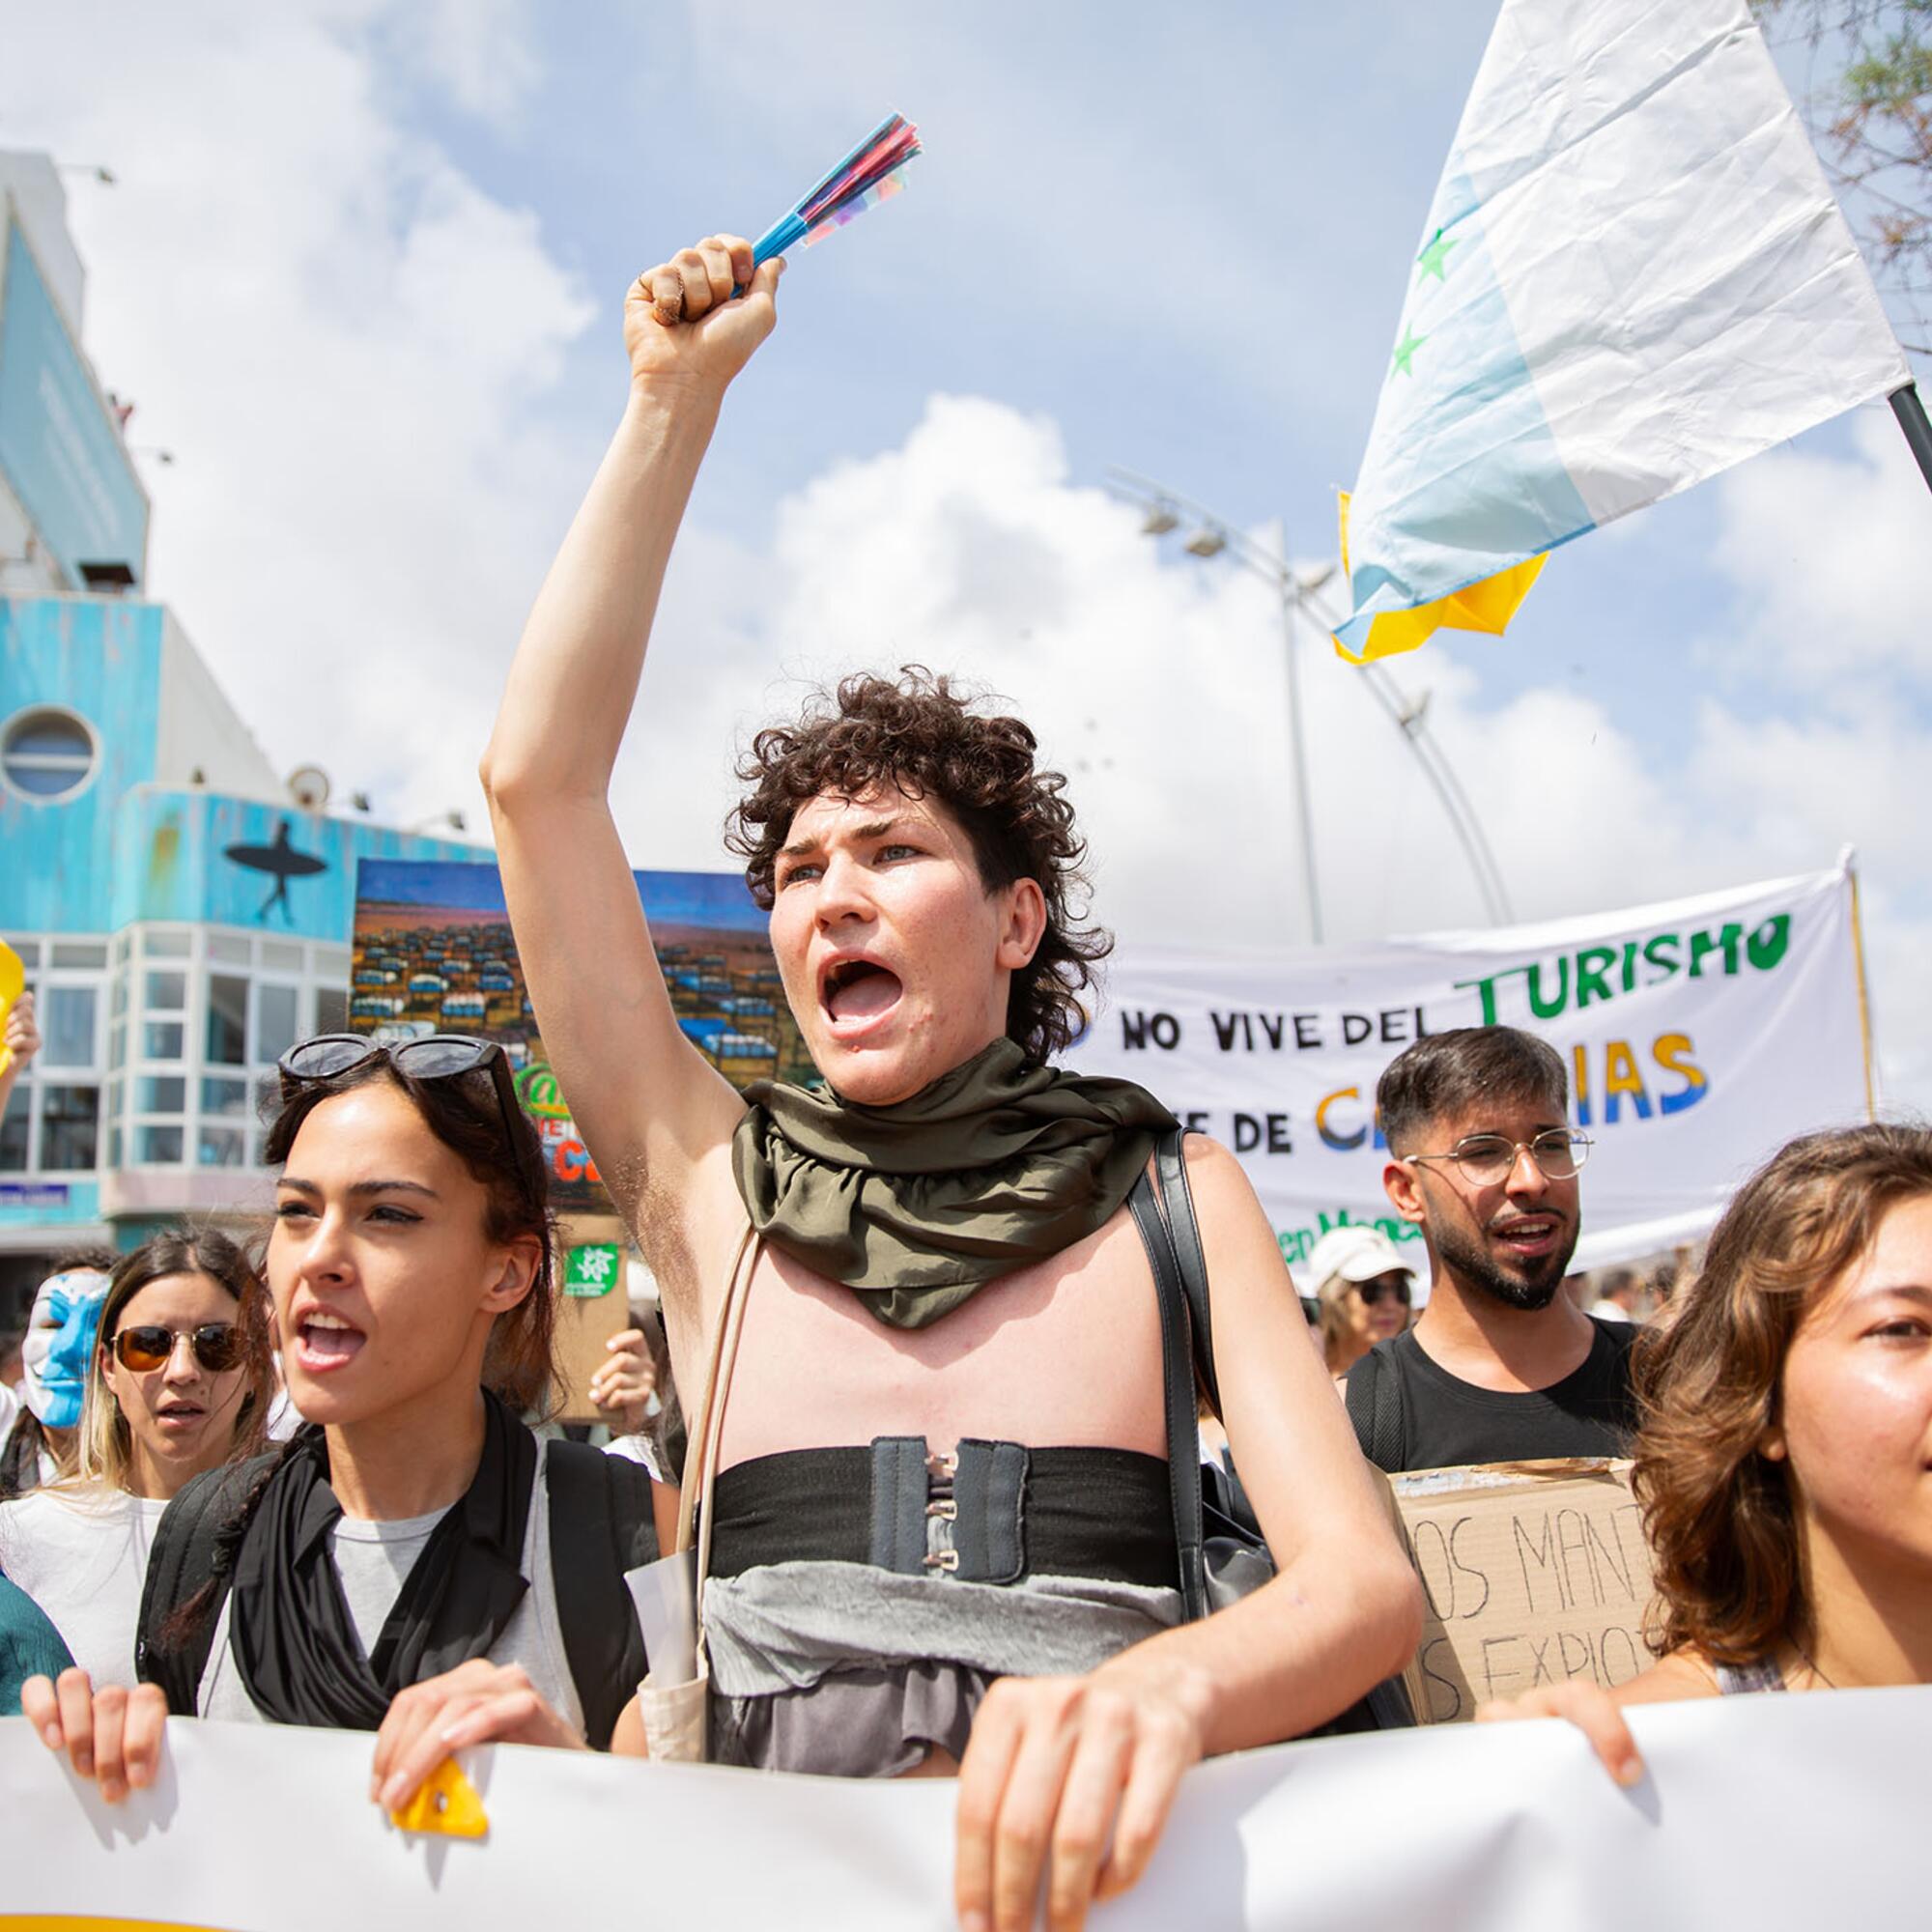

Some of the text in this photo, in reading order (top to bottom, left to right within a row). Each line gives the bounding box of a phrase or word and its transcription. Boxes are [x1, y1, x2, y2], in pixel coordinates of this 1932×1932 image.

[1120, 1009, 1180, 1051] NO
[1208, 1011, 1322, 1052] VIVE
[1341, 1007, 1434, 1046] DEL
[1453, 913, 1791, 1028] TURISMO
[1233, 1112, 1293, 1153] DE
[1512, 1503, 1656, 1613] MANT
